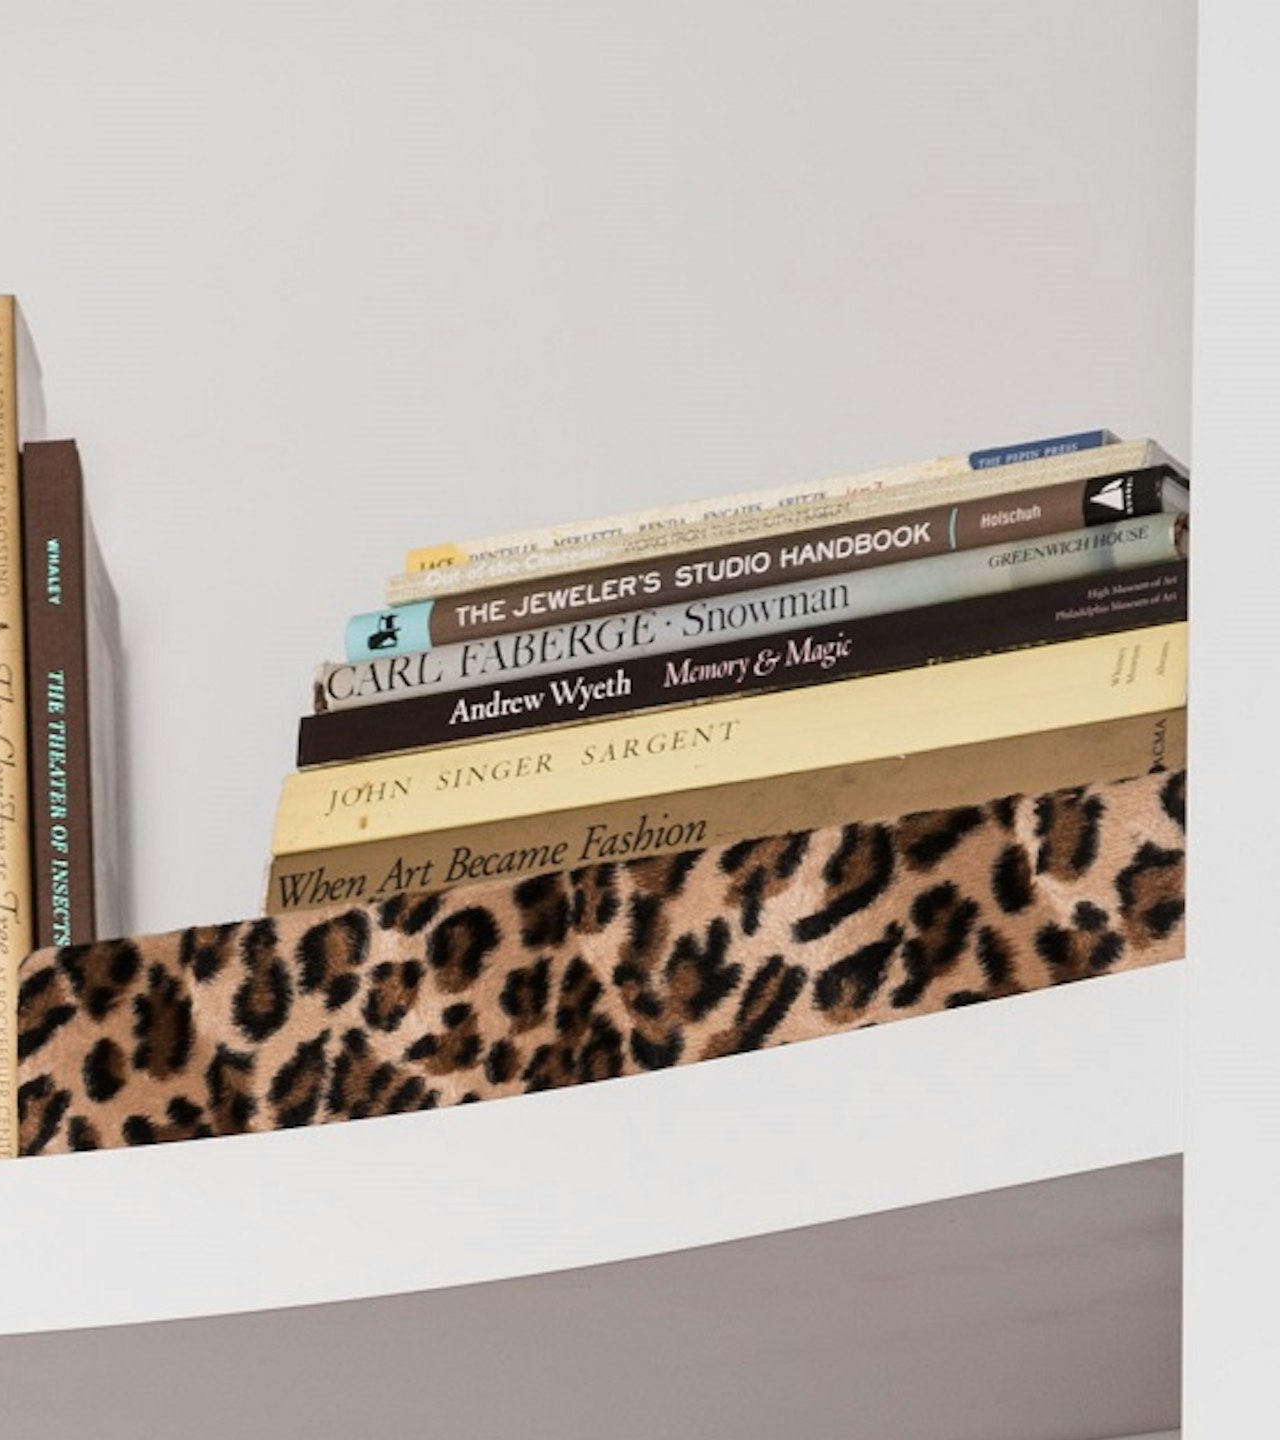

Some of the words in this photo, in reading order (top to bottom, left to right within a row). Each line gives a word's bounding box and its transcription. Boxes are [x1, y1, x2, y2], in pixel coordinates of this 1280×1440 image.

[42, 537, 63, 606] WHALEY
[327, 651, 442, 701] CARL
[459, 608, 657, 679] FABERGE
[682, 581, 850, 638] Snowman
[988, 537, 1090, 569] GREENWICH
[1090, 524, 1150, 552] HOUSE
[454, 601, 506, 627] THE
[512, 572, 662, 617] JEWELER'S
[675, 551, 771, 588] STUDIO
[780, 521, 932, 567] HANDBOOK
[43, 669, 67, 714] THE
[448, 686, 545, 725] Andrew
[551, 669, 633, 711] Wyeth
[663, 652, 749, 688] Memory
[753, 647, 782, 676] &
[786, 632, 853, 666] Magic
[43, 719, 73, 820] THEATER
[324, 775, 414, 817] JOHN
[437, 752, 554, 791] SINGER
[581, 717, 740, 767] SARGENT
[49, 823, 70, 854] OF
[279, 870, 367, 908] When
[379, 856, 433, 891] Art
[444, 840, 567, 884] Became
[579, 815, 707, 862] Fashion
[45, 858, 75, 949] INSECTS
